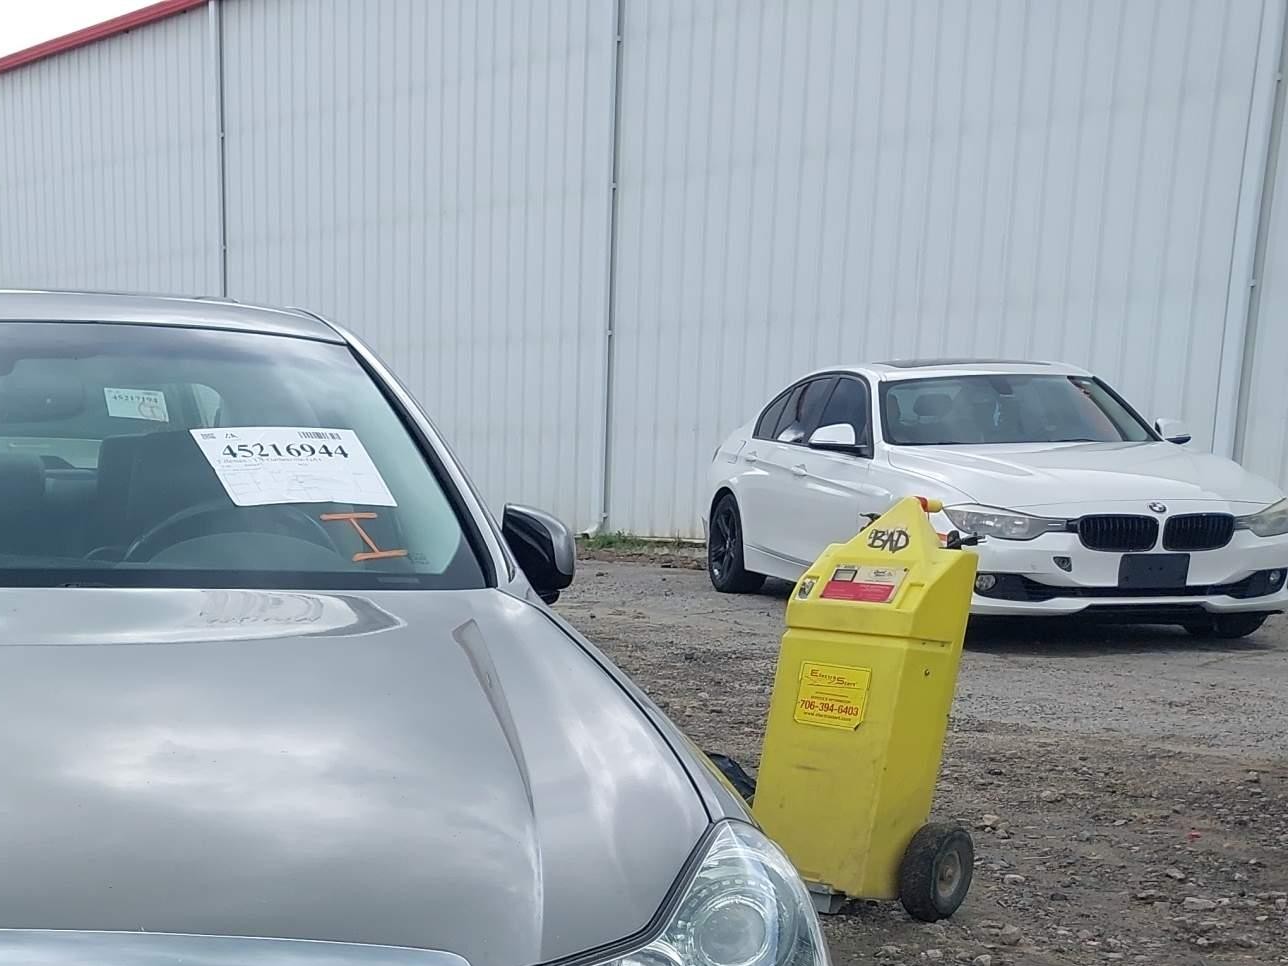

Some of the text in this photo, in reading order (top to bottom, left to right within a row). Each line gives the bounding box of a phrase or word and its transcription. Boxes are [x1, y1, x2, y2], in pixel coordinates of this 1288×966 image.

[222, 442, 349, 458] 45216944
[867, 528, 910, 553] BAD
[799, 699, 859, 717] 706-394-6403
